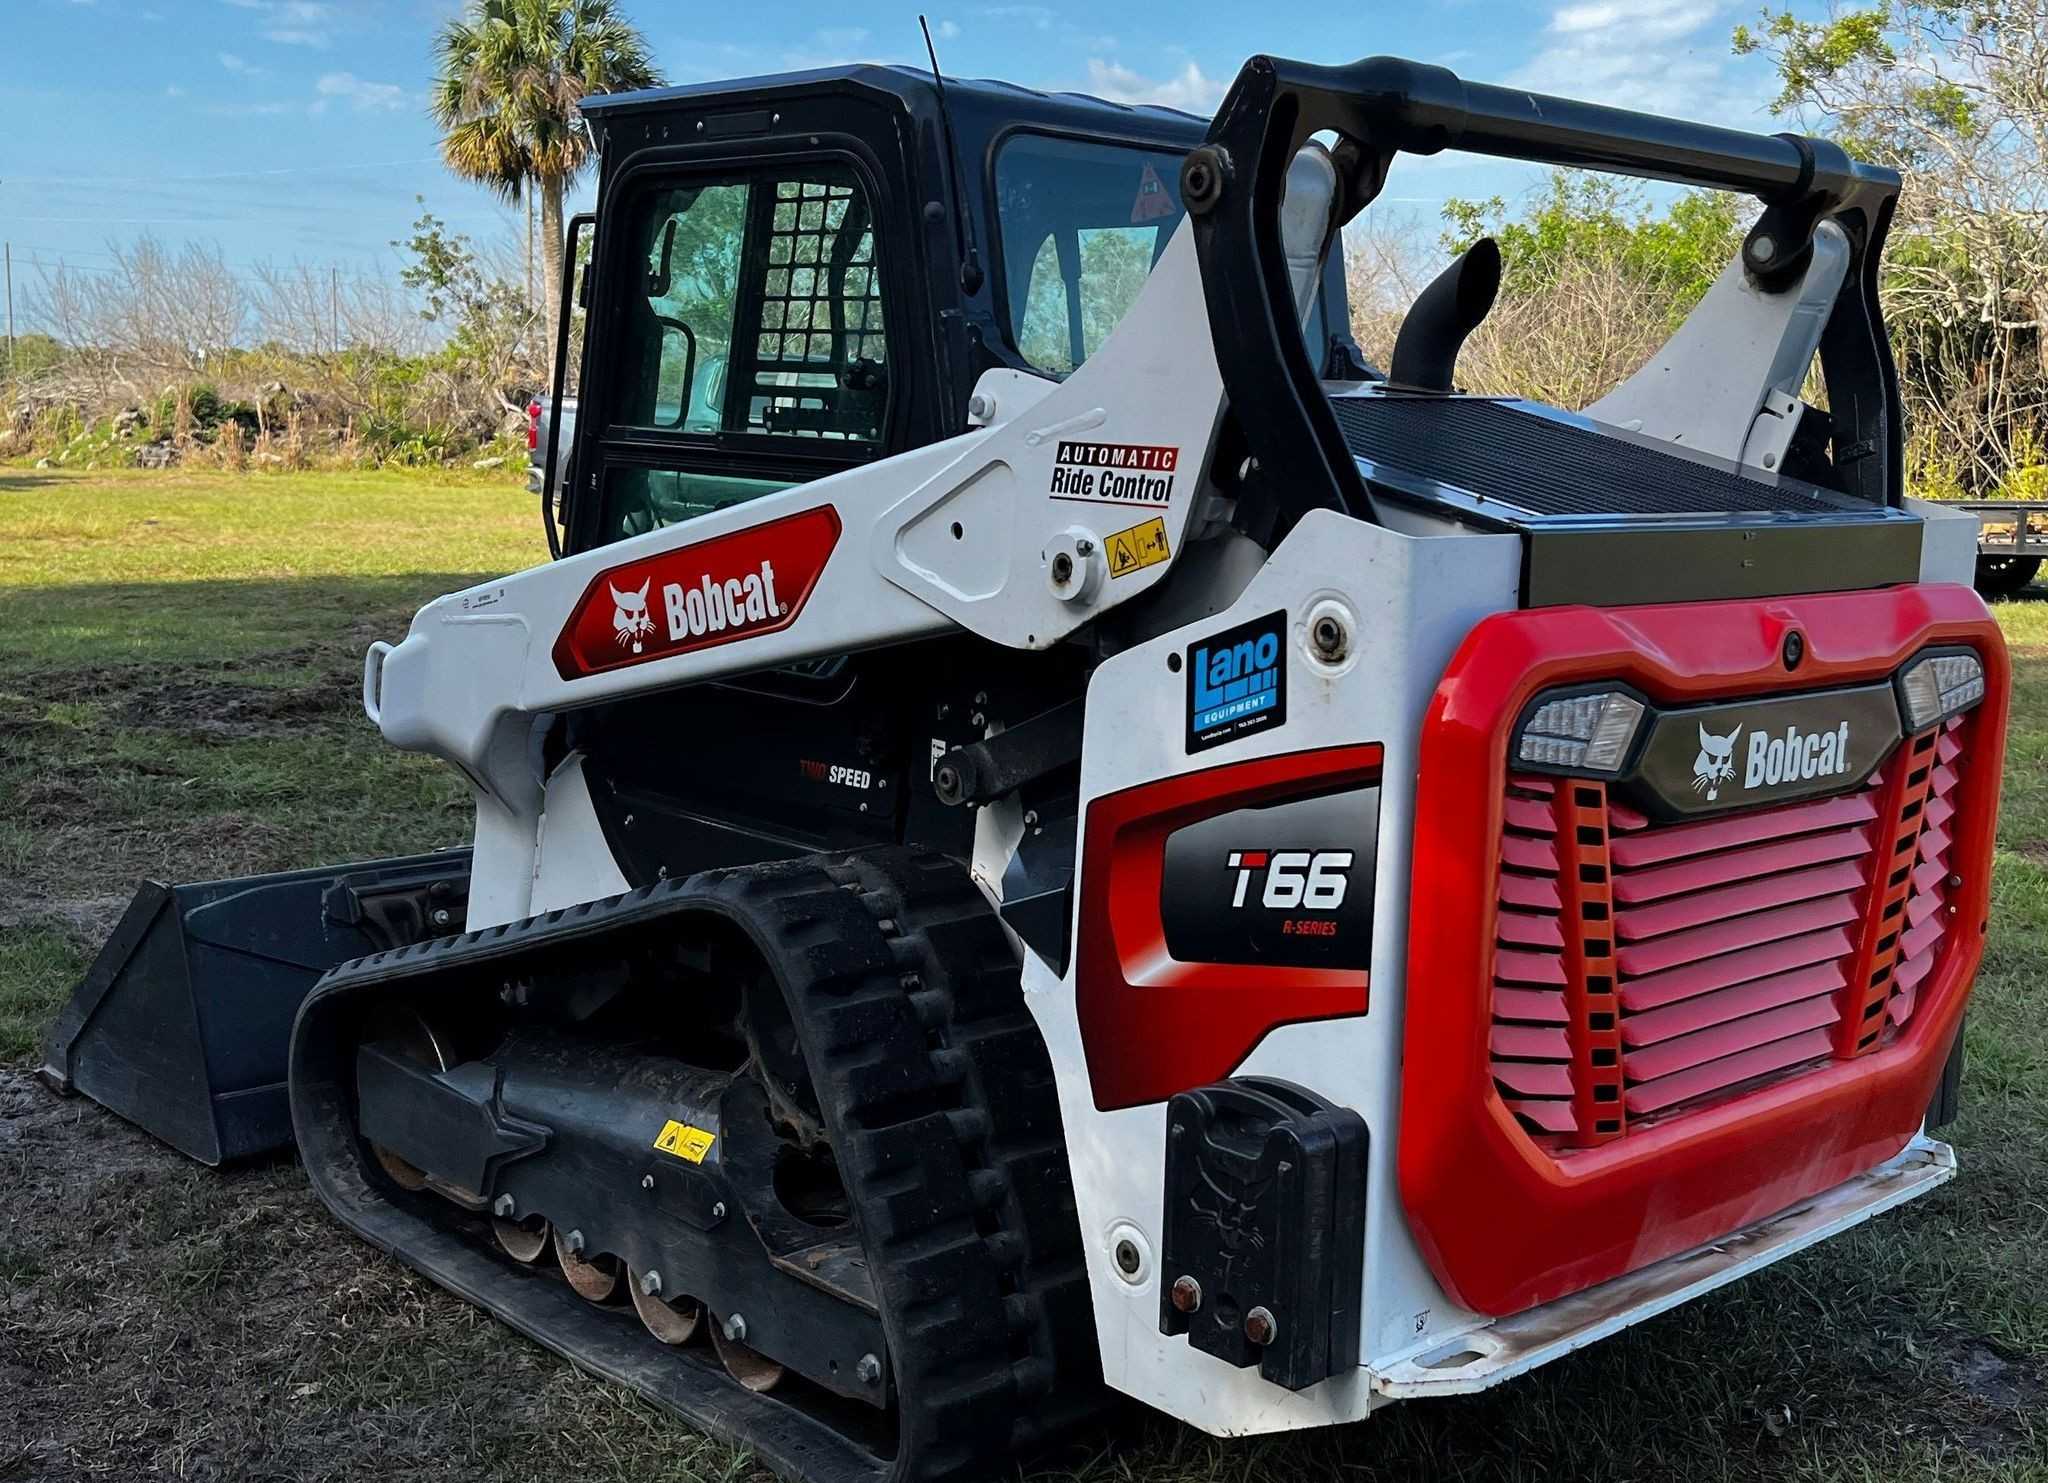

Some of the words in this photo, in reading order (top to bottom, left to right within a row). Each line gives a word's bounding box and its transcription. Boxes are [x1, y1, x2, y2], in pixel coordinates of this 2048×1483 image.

[1060, 445, 1173, 469] AUTOMATIC
[1050, 467, 1094, 495] Ride
[1099, 470, 1174, 501] Control
[663, 560, 780, 641] Bobcat
[1194, 632, 1278, 712] Lano
[1203, 695, 1266, 724] EQUIPMENT
[1744, 720, 1848, 789] Bobcat
[800, 759, 826, 777] TWO
[829, 765, 871, 789] SPEED
[1228, 852, 1353, 909] T66
[1283, 920, 1337, 936] R-SERIES
